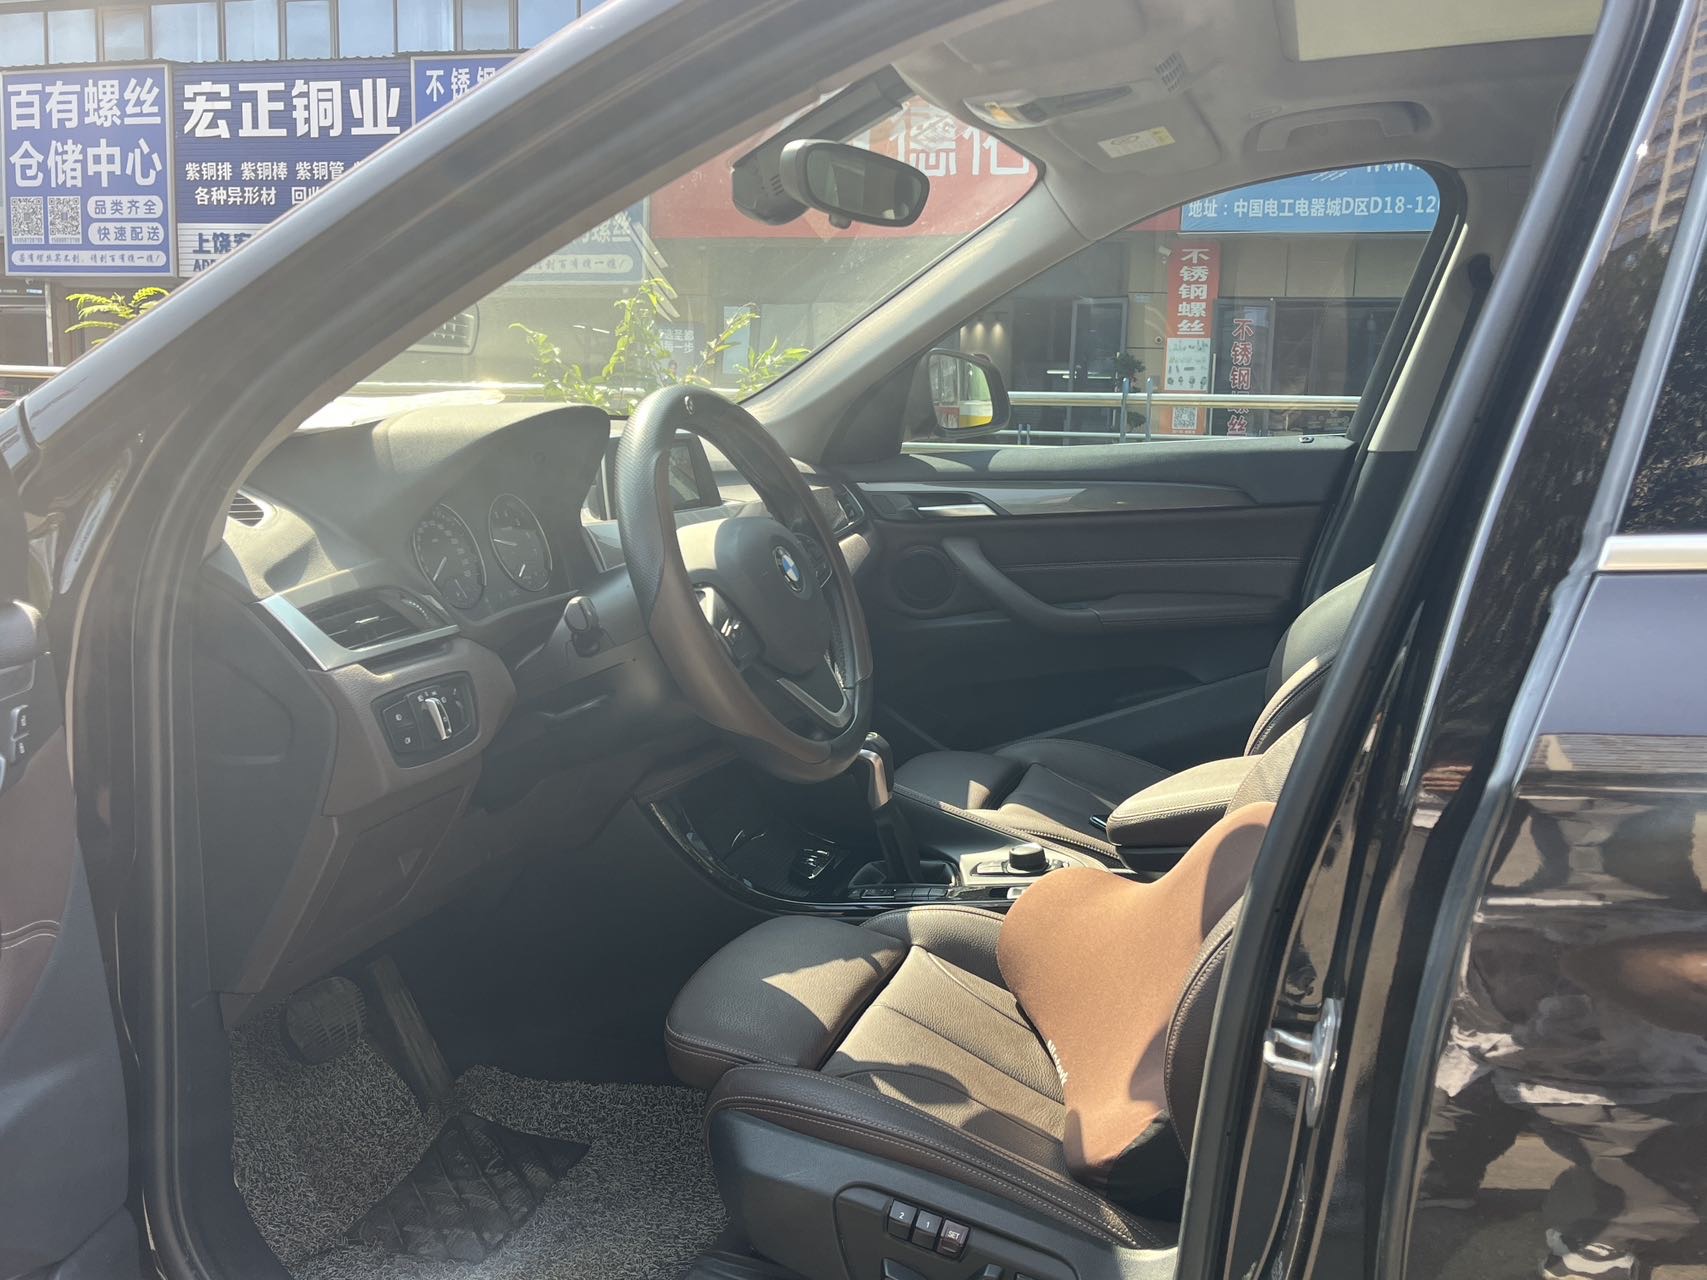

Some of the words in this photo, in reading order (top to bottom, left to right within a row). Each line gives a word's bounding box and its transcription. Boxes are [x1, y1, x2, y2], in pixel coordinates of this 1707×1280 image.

[7, 78, 162, 130] 百有螺丝
[183, 78, 401, 139] 宏正铜业
[9, 138, 163, 188] 仓储中心
[185, 162, 233, 181] 紫铜排
[241, 161, 289, 181] 紫铜棒
[295, 161, 345, 181] 紫铜管
[94, 200, 157, 215] 品类齐全
[194, 186, 277, 205] 各种异形材
[1187, 195, 1440, 218] 地址：中国电工电器城D区D18-12
[97, 226, 160, 241] 快速配送
[1177, 248, 1210, 335] 不锈钢螺丝
[1226, 318, 1255, 437] 不锈钢丝
[898, 1212, 905, 1220] 2
[947, 1231, 960, 1239] SET
